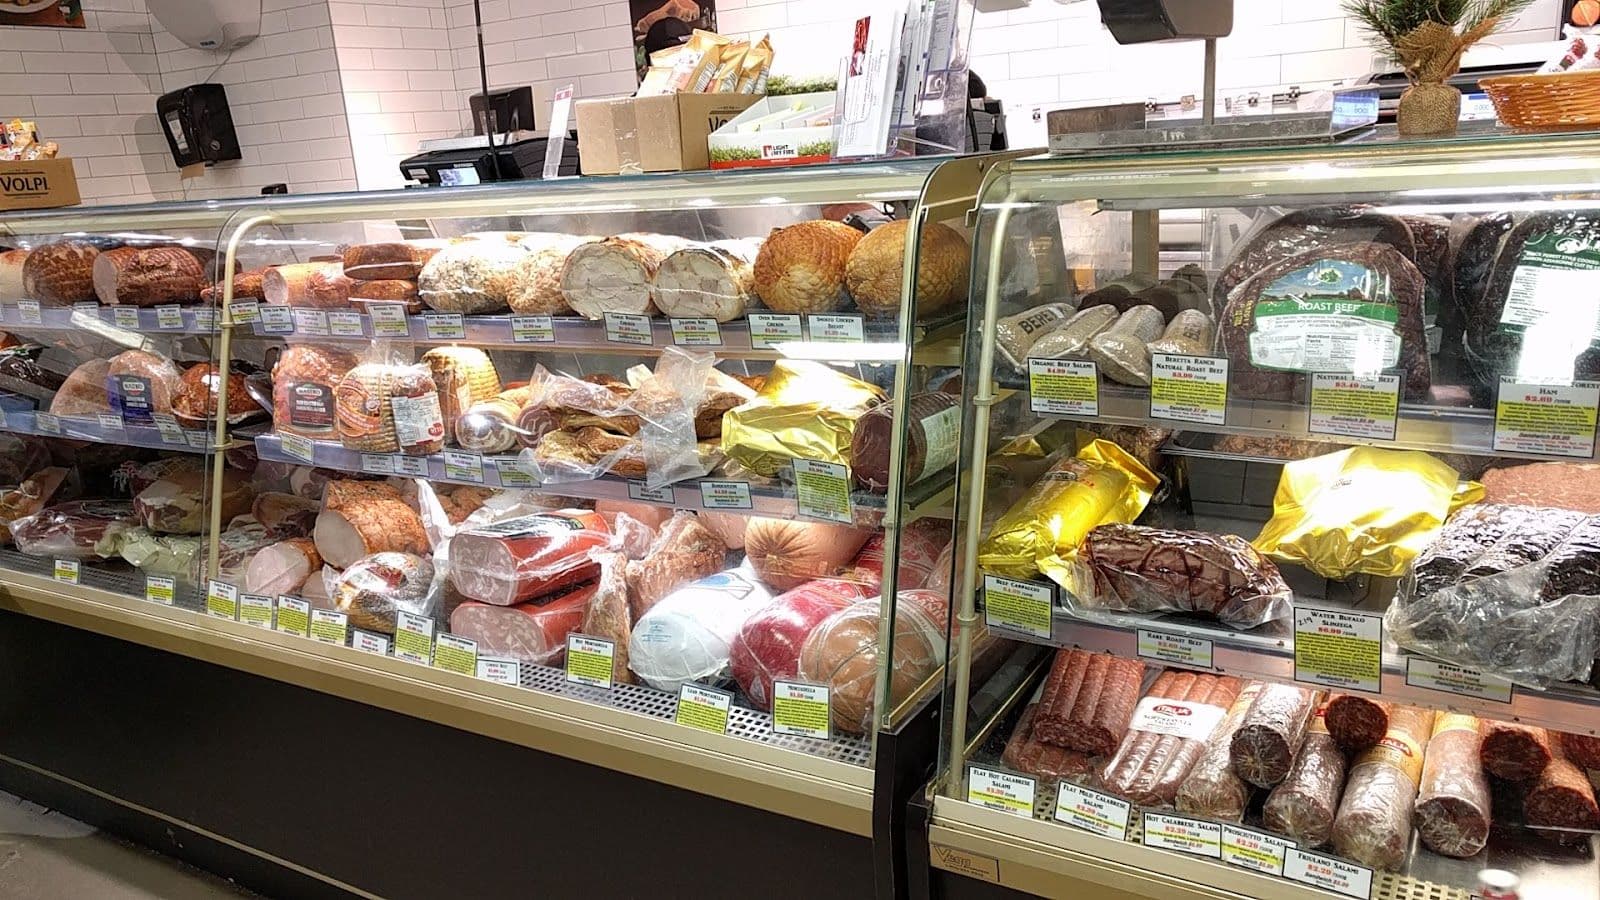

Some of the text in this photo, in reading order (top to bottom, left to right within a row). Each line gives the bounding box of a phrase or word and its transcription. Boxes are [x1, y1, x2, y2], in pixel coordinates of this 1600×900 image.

[0, 176, 48, 192] VOLPI
[1298, 302, 1360, 312] ROAST BEEF
[1165, 356, 1191, 364] BERETTA
[1339, 615, 1365, 623] BUFALO
[1322, 620, 1353, 629] SLINZEGA
[1147, 632, 1162, 640] RARE
[700, 692, 724, 701] MORTADELLA
[992, 781, 1011, 789] SALAMI
[1002, 776, 1030, 786] CALABRESE
[1063, 784, 1127, 809] FLAT MILD CALABRESE
[1083, 799, 1104, 809] SALAMI
[1146, 815, 1220, 832] HOT CALABRESE SALAMI
[1224, 827, 1262, 842] PROSCIUTTO
[1163, 837, 1188, 846] Sandwich
[1232, 854, 1258, 865] Sandwich
[1298, 853, 1359, 874] FRIULANO SALAMI
[1305, 872, 1332, 883] Sandwich
